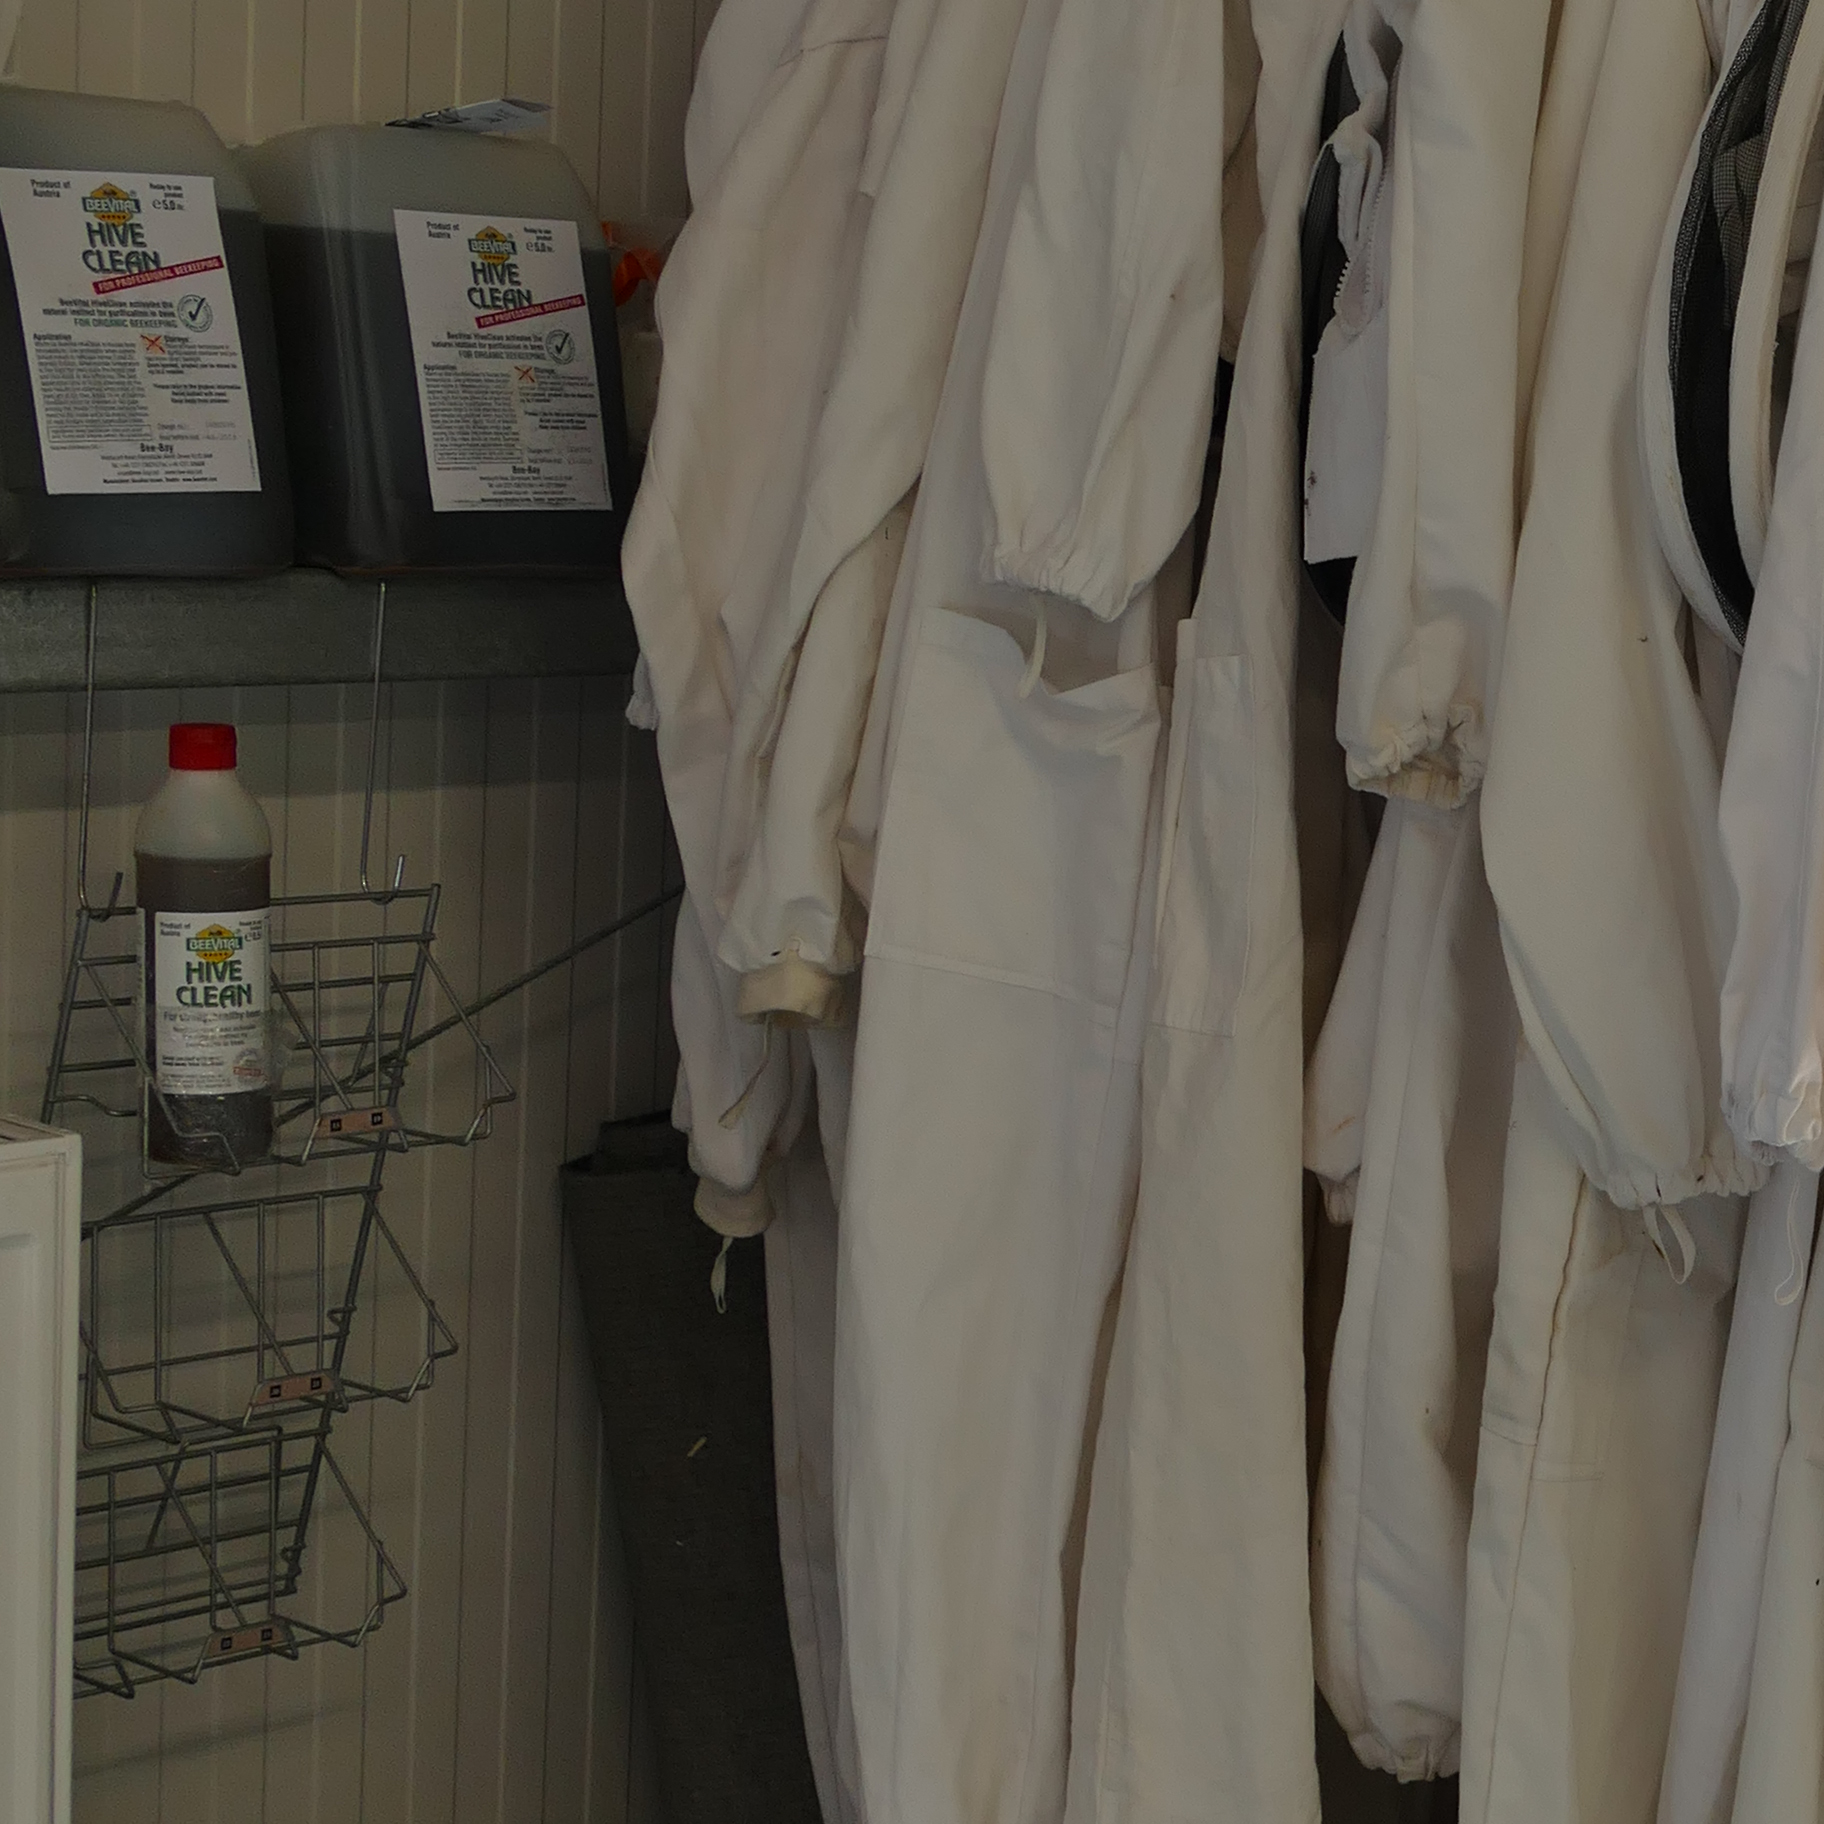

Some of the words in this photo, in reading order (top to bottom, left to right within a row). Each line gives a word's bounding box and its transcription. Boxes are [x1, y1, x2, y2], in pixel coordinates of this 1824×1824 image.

[30, 179, 61, 189] Product
[33, 189, 60, 198] Austria
[86, 199, 137, 213] BEEVITAL
[86, 222, 147, 248] HIVE
[427, 221, 451, 230] Product
[471, 240, 513, 253] BEEVITAL
[82, 249, 161, 275] CLEAN
[98, 281, 115, 292] FOR
[116, 269, 174, 286] PROFESSIONAL
[175, 260, 219, 275] BEEKEEPING
[471, 261, 521, 286] HIVE
[467, 287, 533, 310] CLEAN
[495, 305, 543, 322] PROFESSIONAL
[189, 938, 240, 950] BEEVITAL
[186, 960, 243, 984] HIVE
[176, 983, 252, 1008] CLEAN
